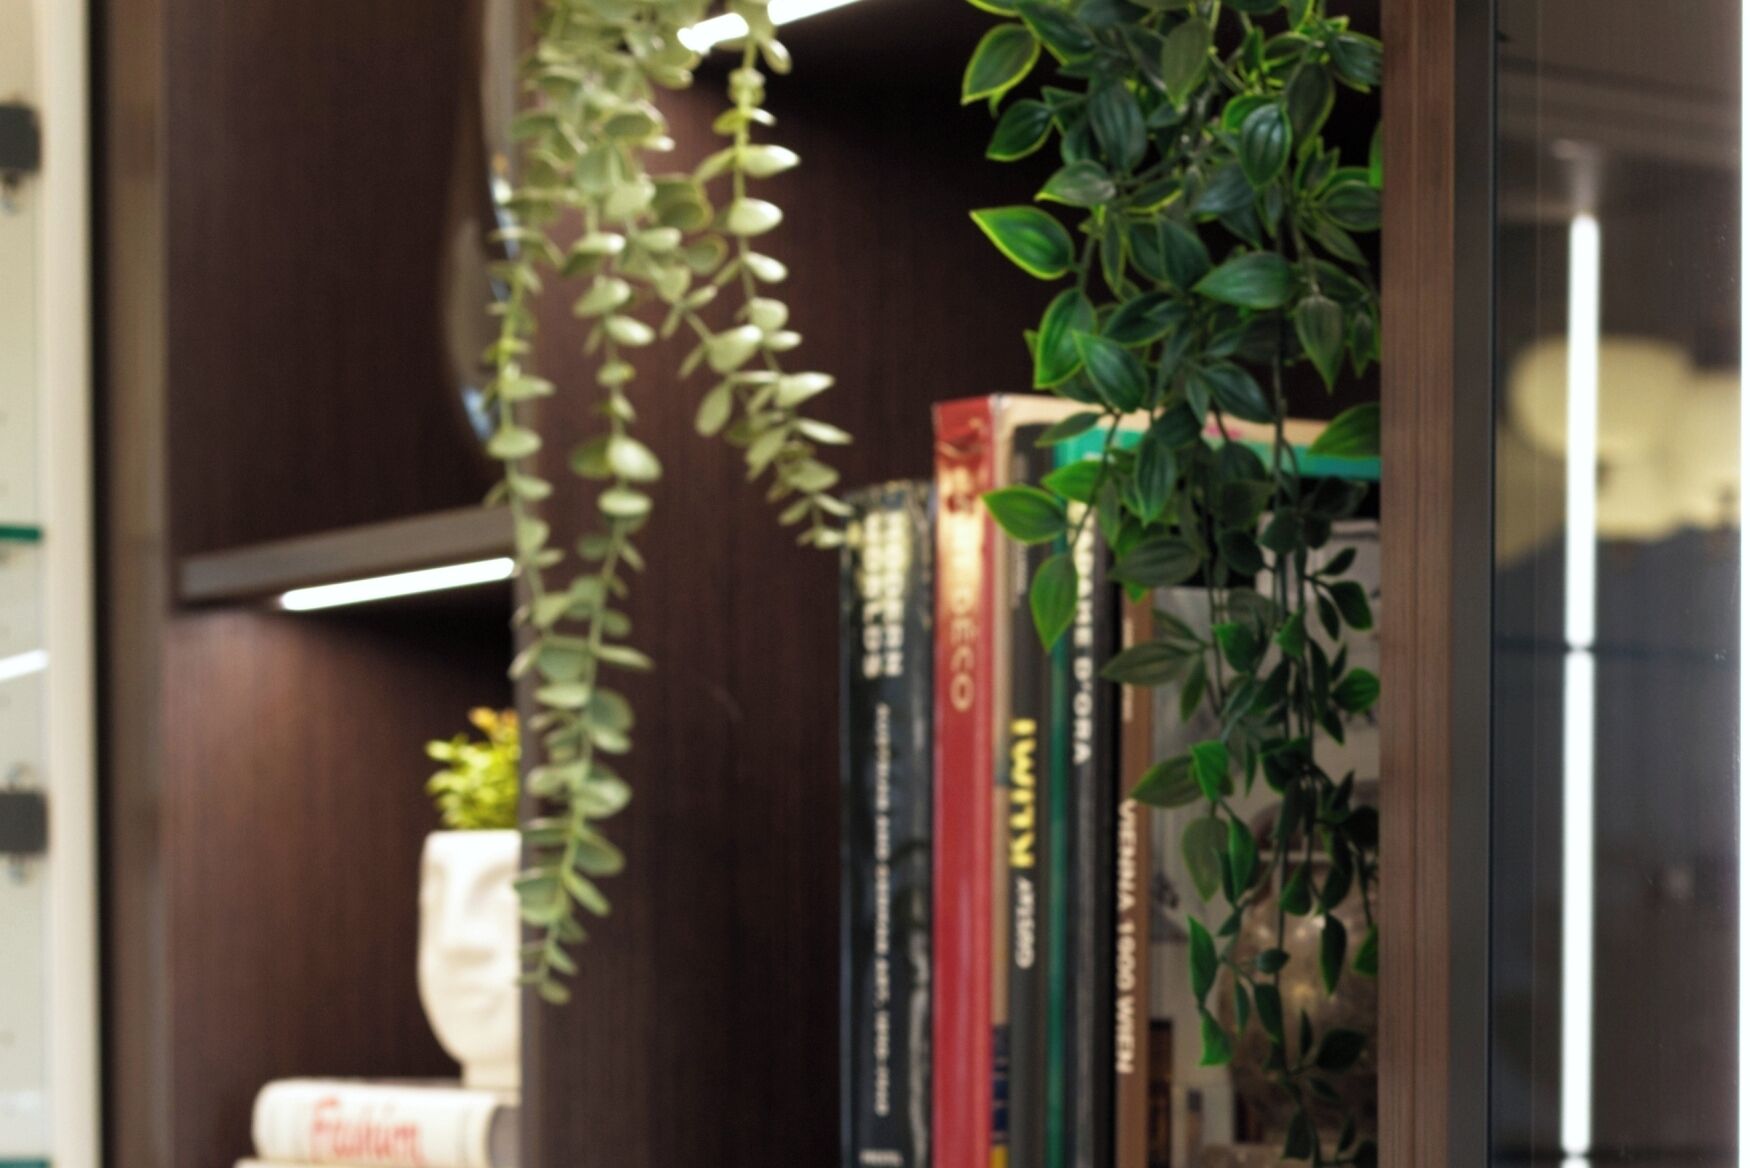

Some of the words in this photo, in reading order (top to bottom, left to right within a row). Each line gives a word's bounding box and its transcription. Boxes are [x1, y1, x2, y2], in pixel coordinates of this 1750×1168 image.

[1117, 798, 1137, 912] VIENNA
[1116, 918, 1136, 991] 1900
[1114, 995, 1136, 1074] WIEN
